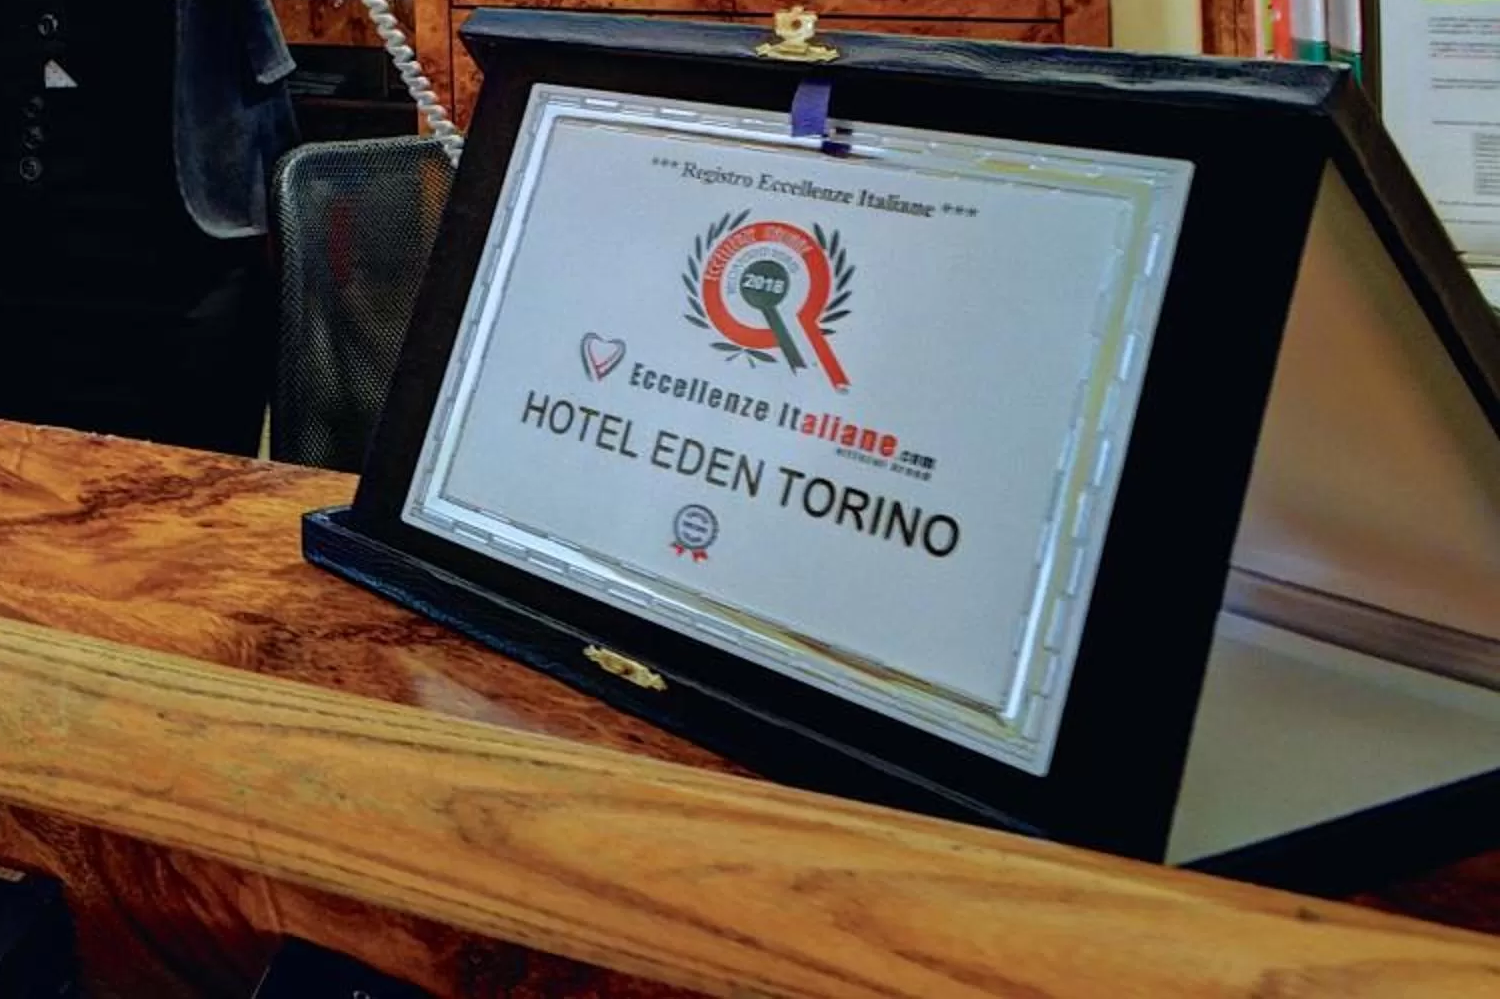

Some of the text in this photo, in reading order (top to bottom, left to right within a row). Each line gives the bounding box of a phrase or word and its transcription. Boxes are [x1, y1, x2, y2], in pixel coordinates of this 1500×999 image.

[681, 161, 936, 218] Registro Eccellenze Italiane
[742, 273, 786, 294] 2018
[628, 362, 771, 422] Eccellenze
[520, 390, 639, 458] HOTEL
[650, 429, 766, 498] EDEN
[779, 466, 961, 558] TORINO
